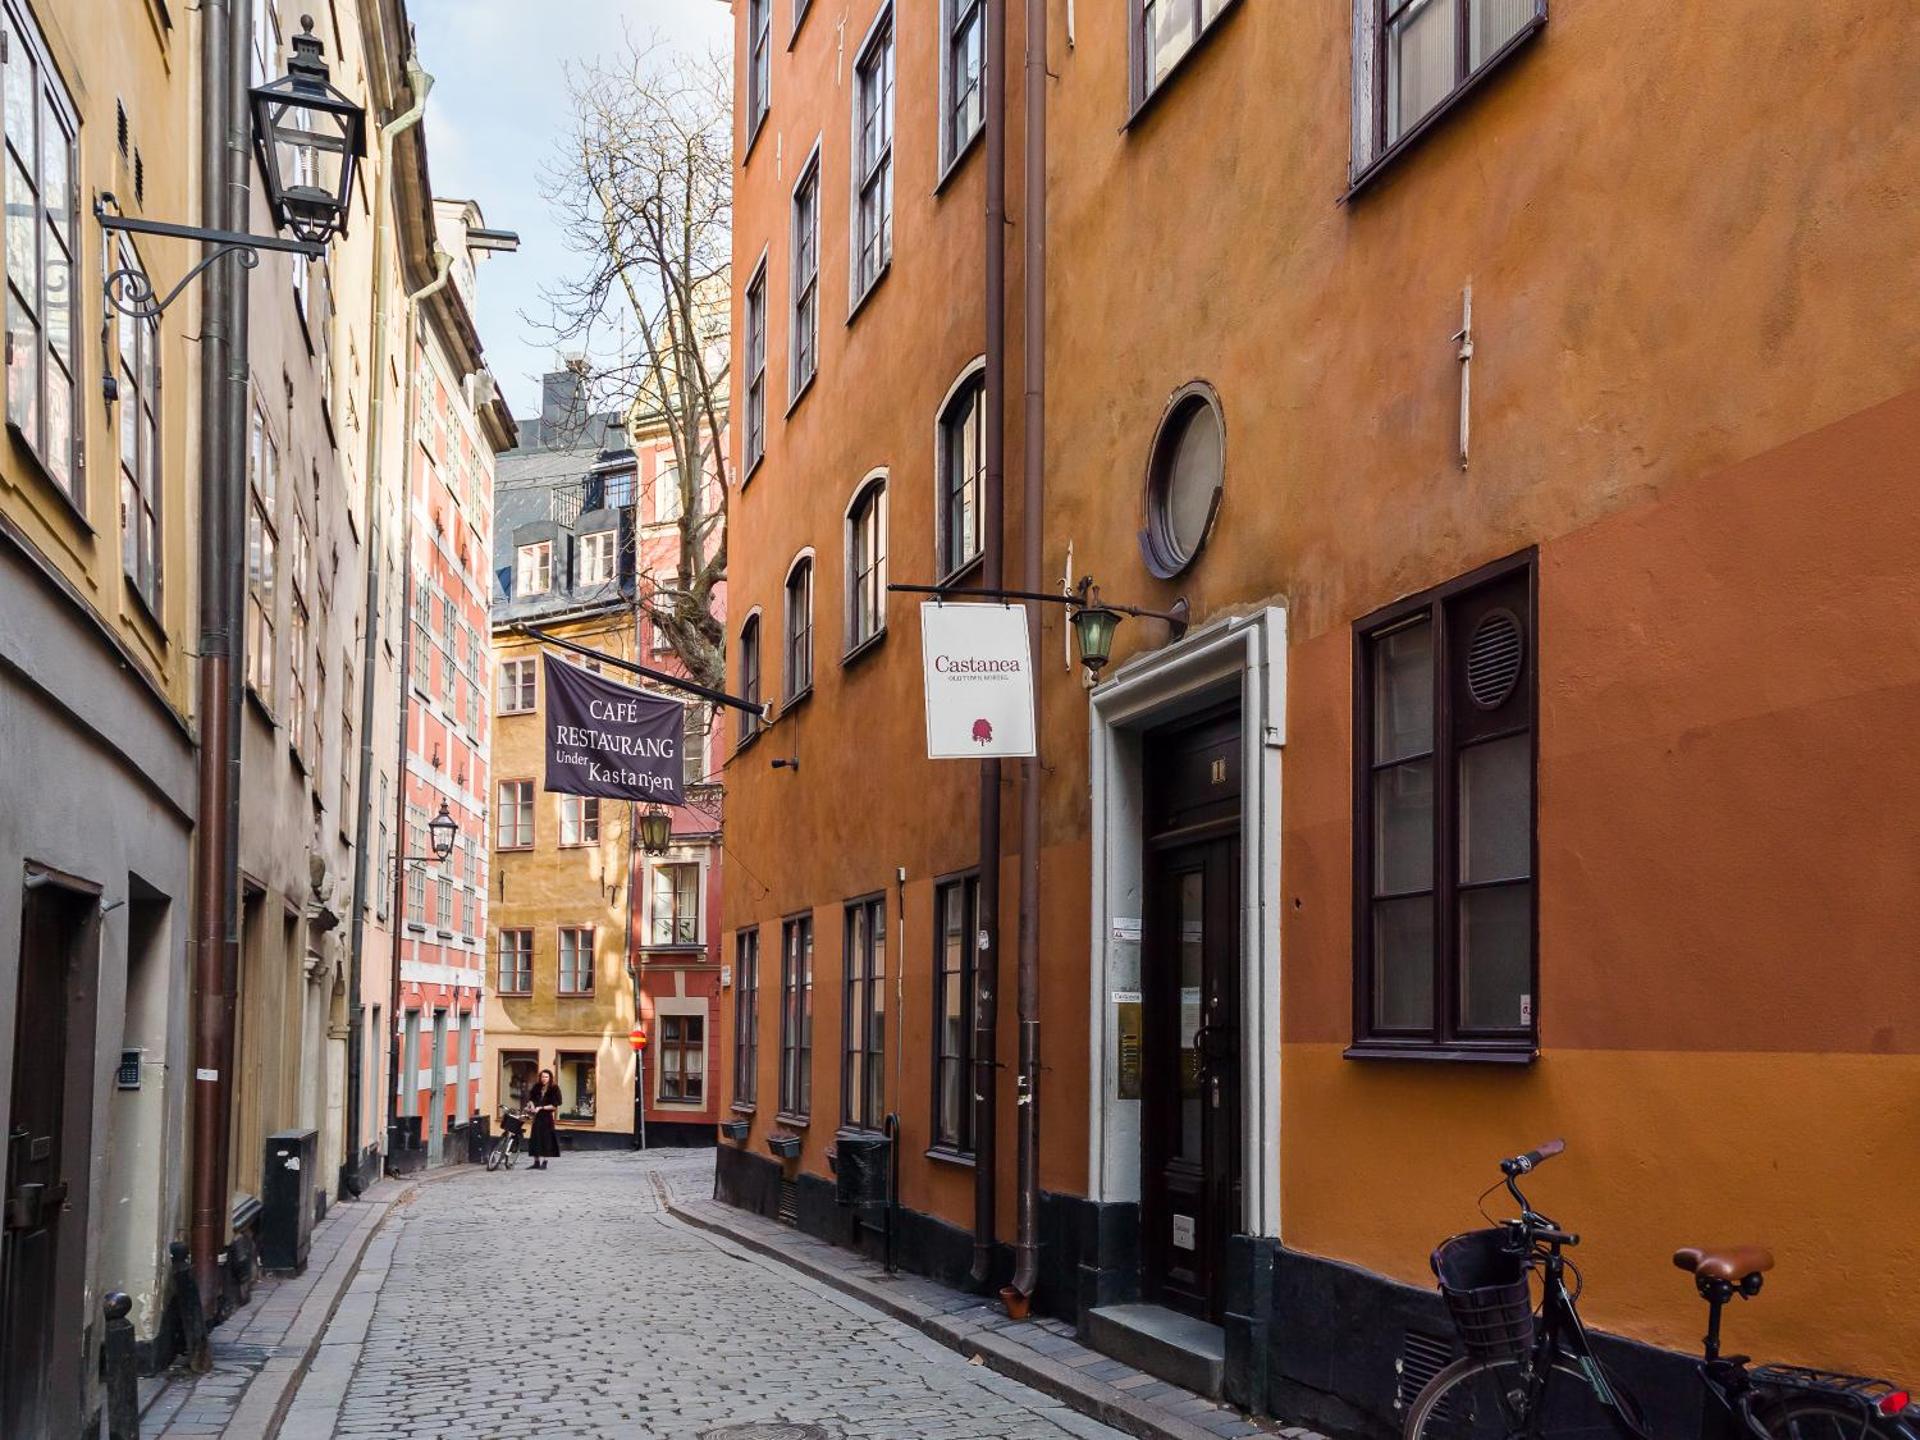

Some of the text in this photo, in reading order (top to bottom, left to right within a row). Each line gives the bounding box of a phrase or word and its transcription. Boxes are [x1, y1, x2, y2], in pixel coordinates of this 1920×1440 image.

[935, 654, 1020, 672] Castanea
[589, 699, 638, 723] CAFÉ
[556, 725, 674, 758] RESTAURANG
[556, 750, 589, 765] Under
[588, 762, 674, 793] Kastanjen
